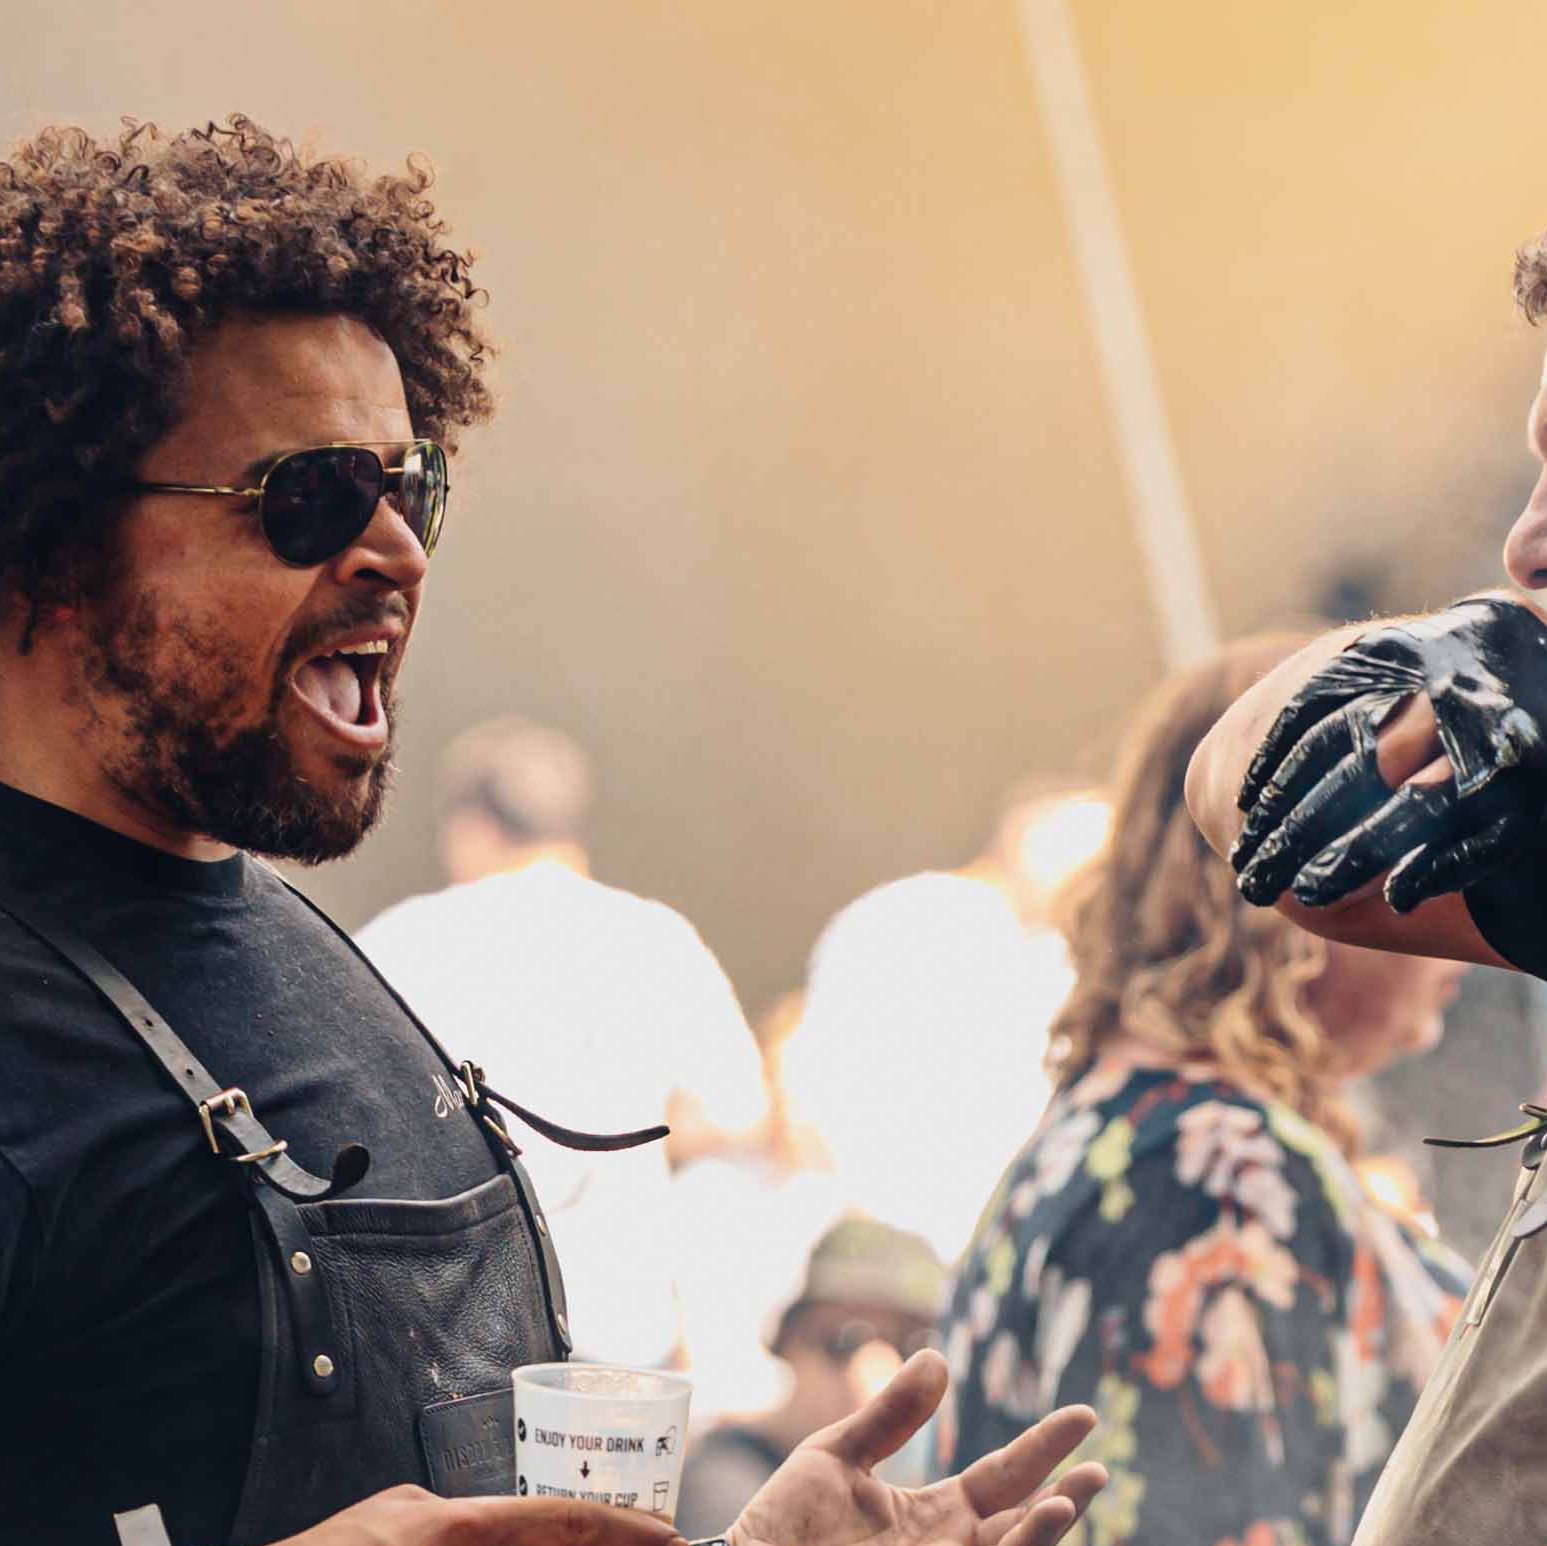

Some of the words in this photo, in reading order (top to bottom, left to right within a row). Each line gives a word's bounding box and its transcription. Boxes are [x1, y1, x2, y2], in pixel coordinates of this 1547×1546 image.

[535, 1428, 566, 1448] ENJOY
[569, 1435, 603, 1451] YOUR
[606, 1437, 645, 1453] DRINK
[614, 1493, 639, 1508] CUP
